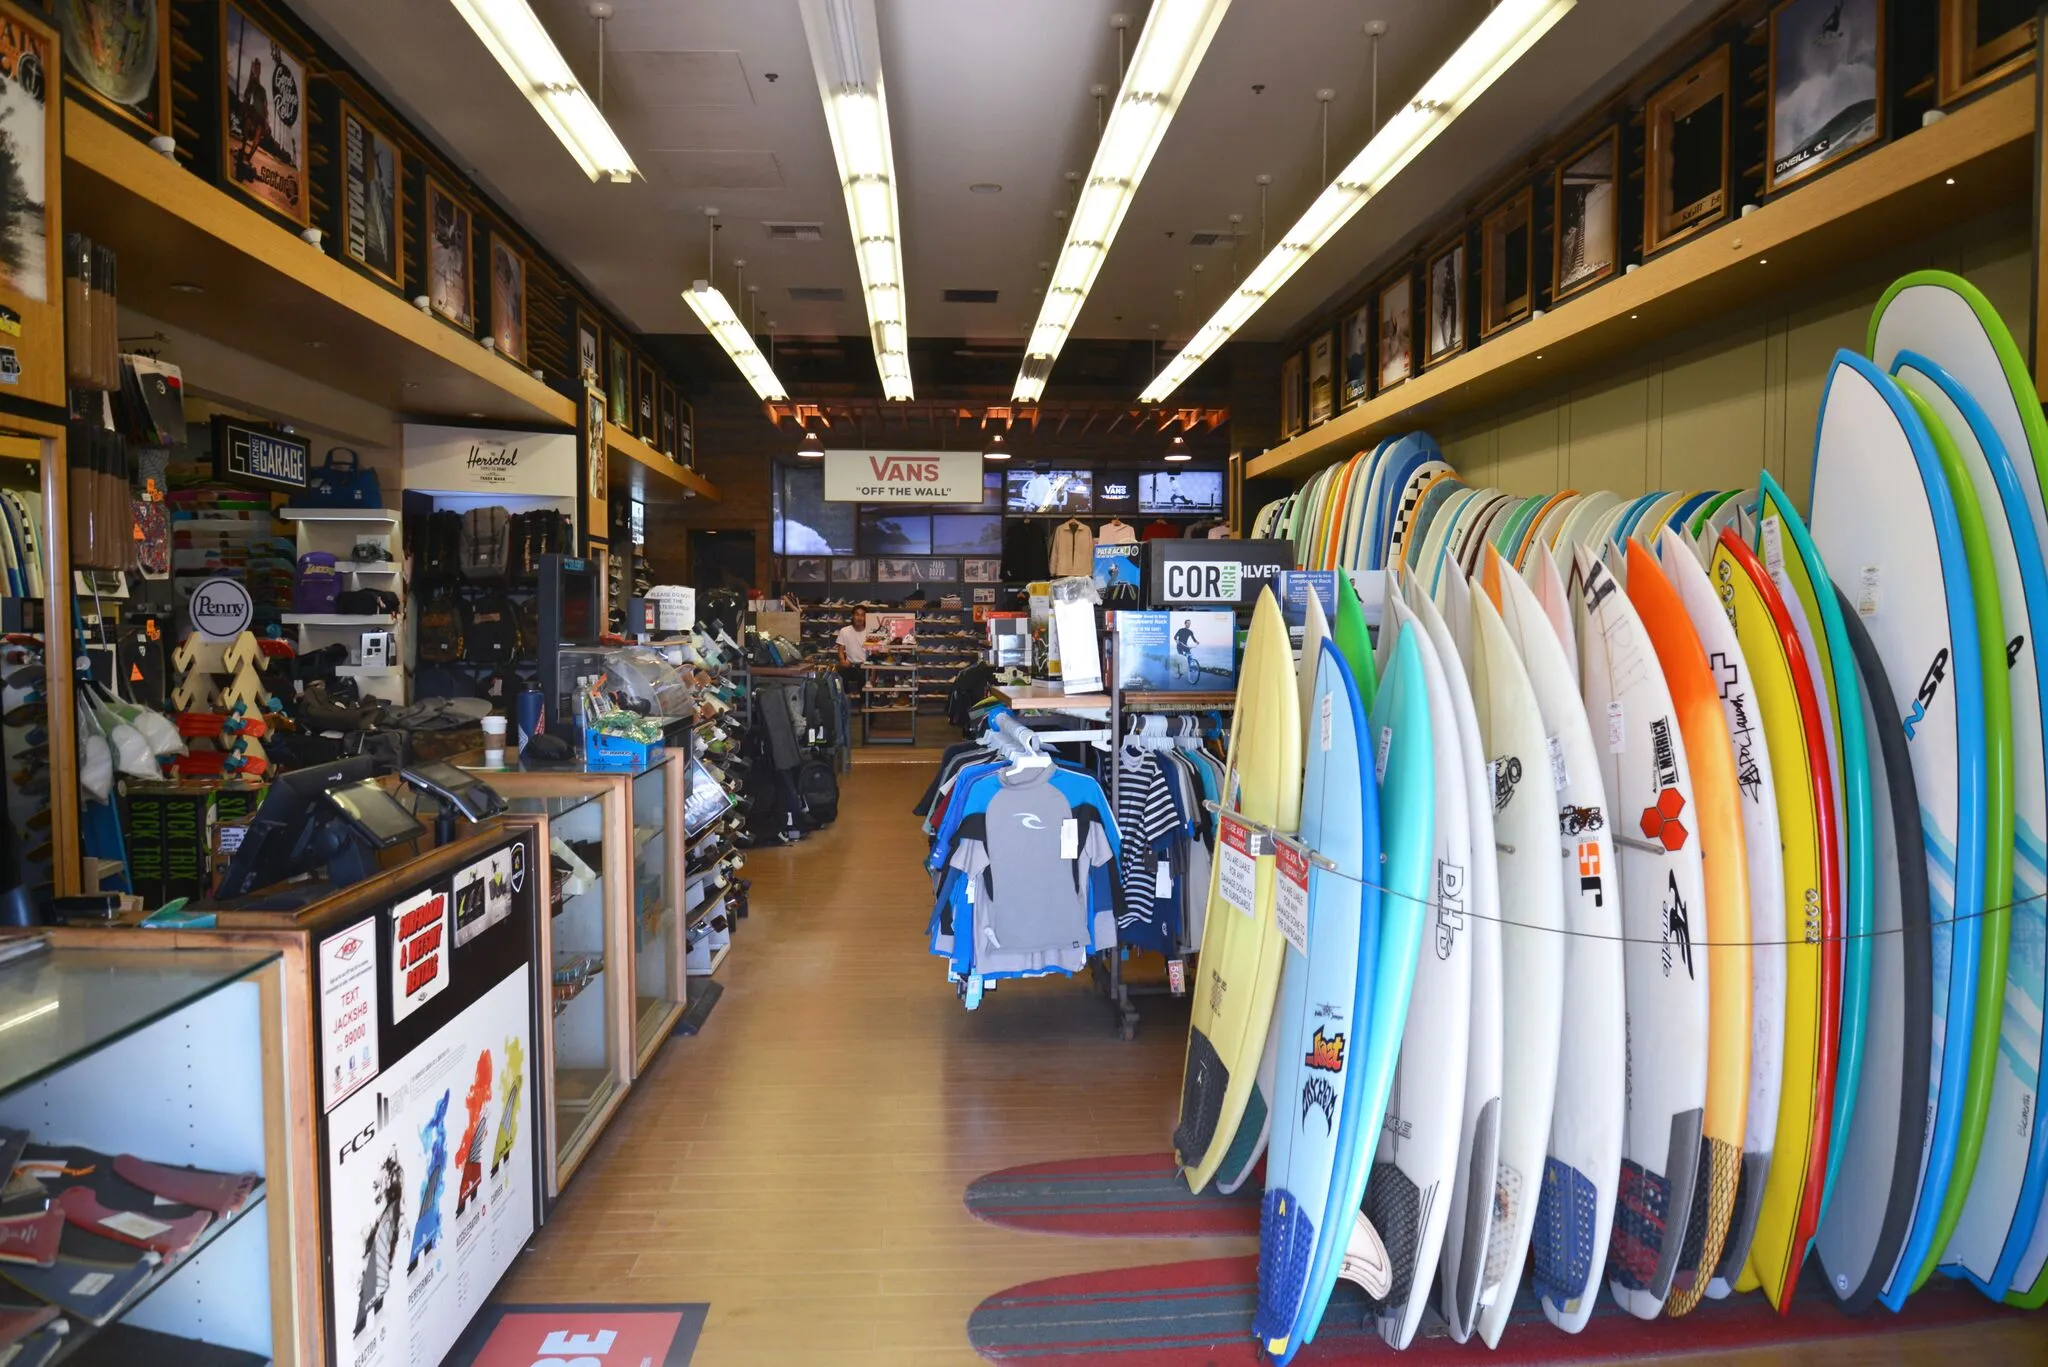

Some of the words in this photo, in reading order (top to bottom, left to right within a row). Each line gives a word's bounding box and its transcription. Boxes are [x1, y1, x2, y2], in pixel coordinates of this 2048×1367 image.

[346, 116, 364, 172] GIRL
[348, 174, 366, 262] MALTO
[259, 441, 304, 481] GARAGE
[466, 445, 518, 469] Herschel
[869, 456, 940, 482] VANS
[856, 487, 885, 496] "OFF
[888, 487, 912, 496] THE
[914, 487, 952, 496] WALL"
[1104, 484, 1127, 495] VANS
[1168, 565, 1221, 598] COR
[199, 595, 245, 616] Penny
[1904, 647, 1949, 742] NSP
[1651, 718, 1674, 771] MERRICK
[1661, 771, 1677, 786] AL
[398, 895, 445, 942] SURFBOARD
[400, 943, 407, 971] &
[408, 922, 443, 966] WETSUIT
[406, 953, 439, 998] RENTALS
[341, 985, 360, 1007] TEXT
[333, 1001, 368, 1034] JACKSHB
[344, 1023, 366, 1048] 99000
[339, 1121, 376, 1166] FCS
[407, 1267, 434, 1306] PERFORMER
